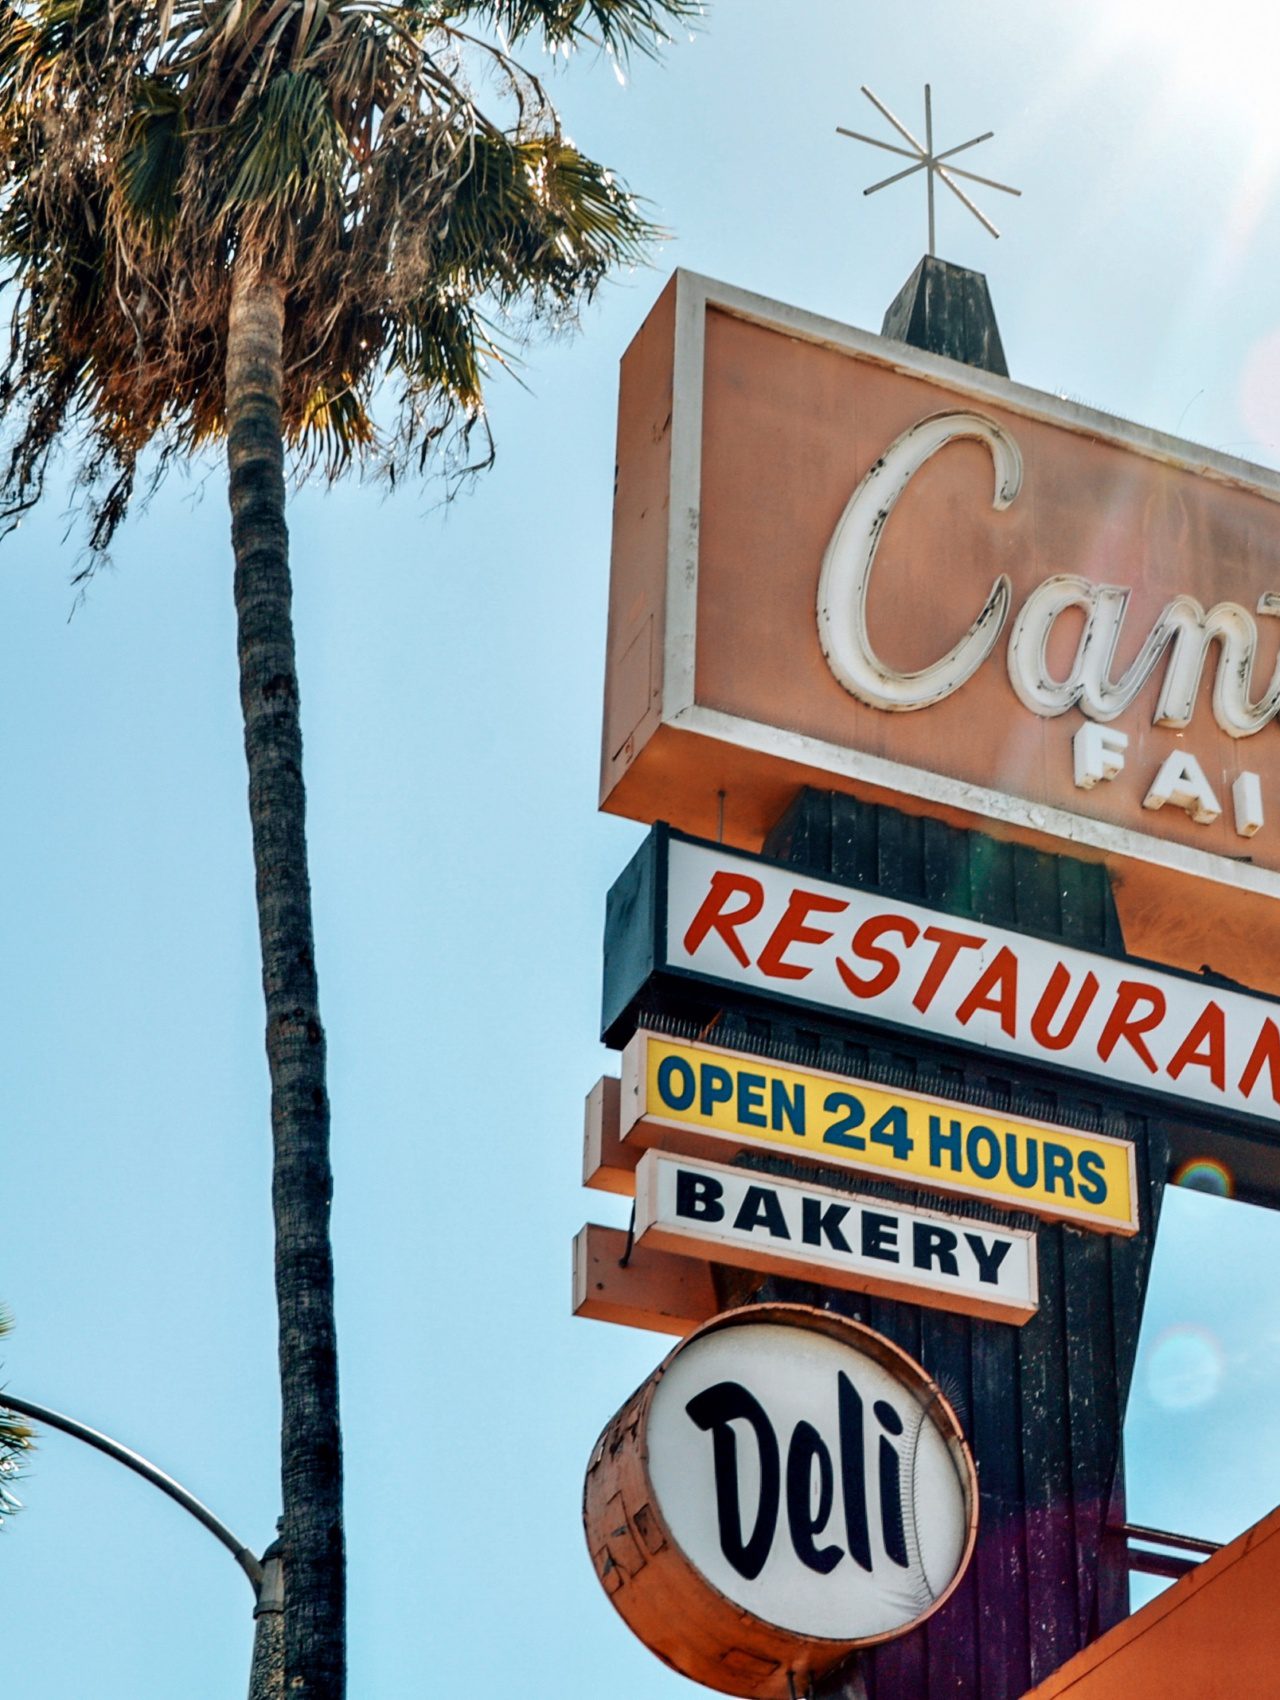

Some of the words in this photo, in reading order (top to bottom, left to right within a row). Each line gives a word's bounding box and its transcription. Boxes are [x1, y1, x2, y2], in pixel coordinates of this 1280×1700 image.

[657, 1055, 805, 1136] OPEN
[823, 1092, 914, 1162] 24
[930, 1116, 1107, 1206] HOURS
[676, 1170, 1014, 1286] BAKERY
[686, 1370, 908, 1580] Deli
